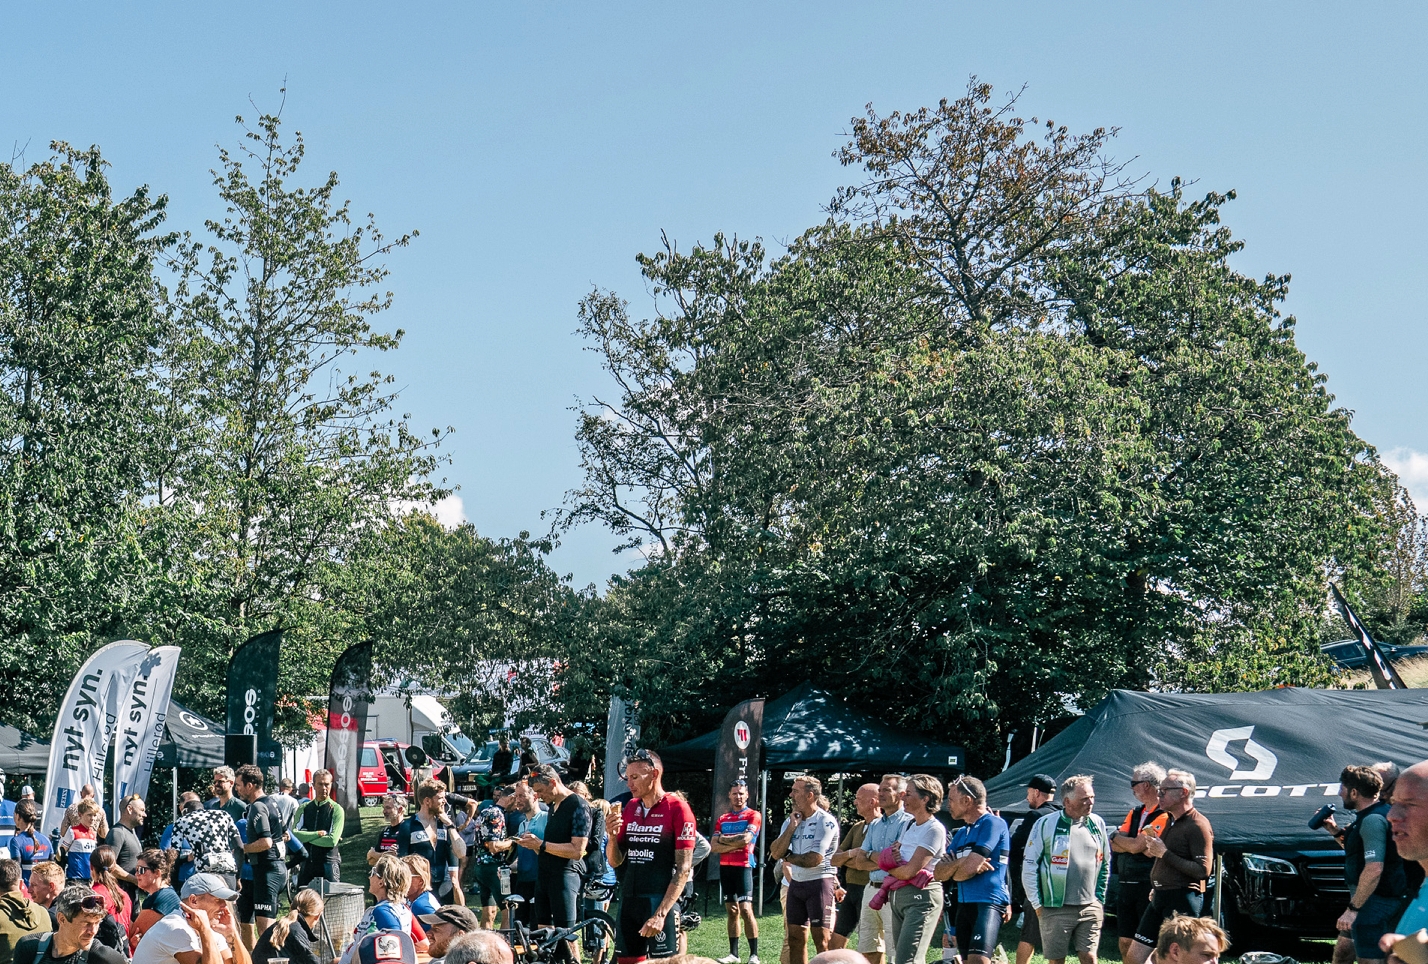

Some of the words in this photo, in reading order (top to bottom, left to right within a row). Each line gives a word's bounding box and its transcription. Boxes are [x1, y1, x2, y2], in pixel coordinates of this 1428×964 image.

[72, 668, 103, 722] syn.
[63, 725, 85, 771] nyt
[123, 727, 138, 766] nyt
